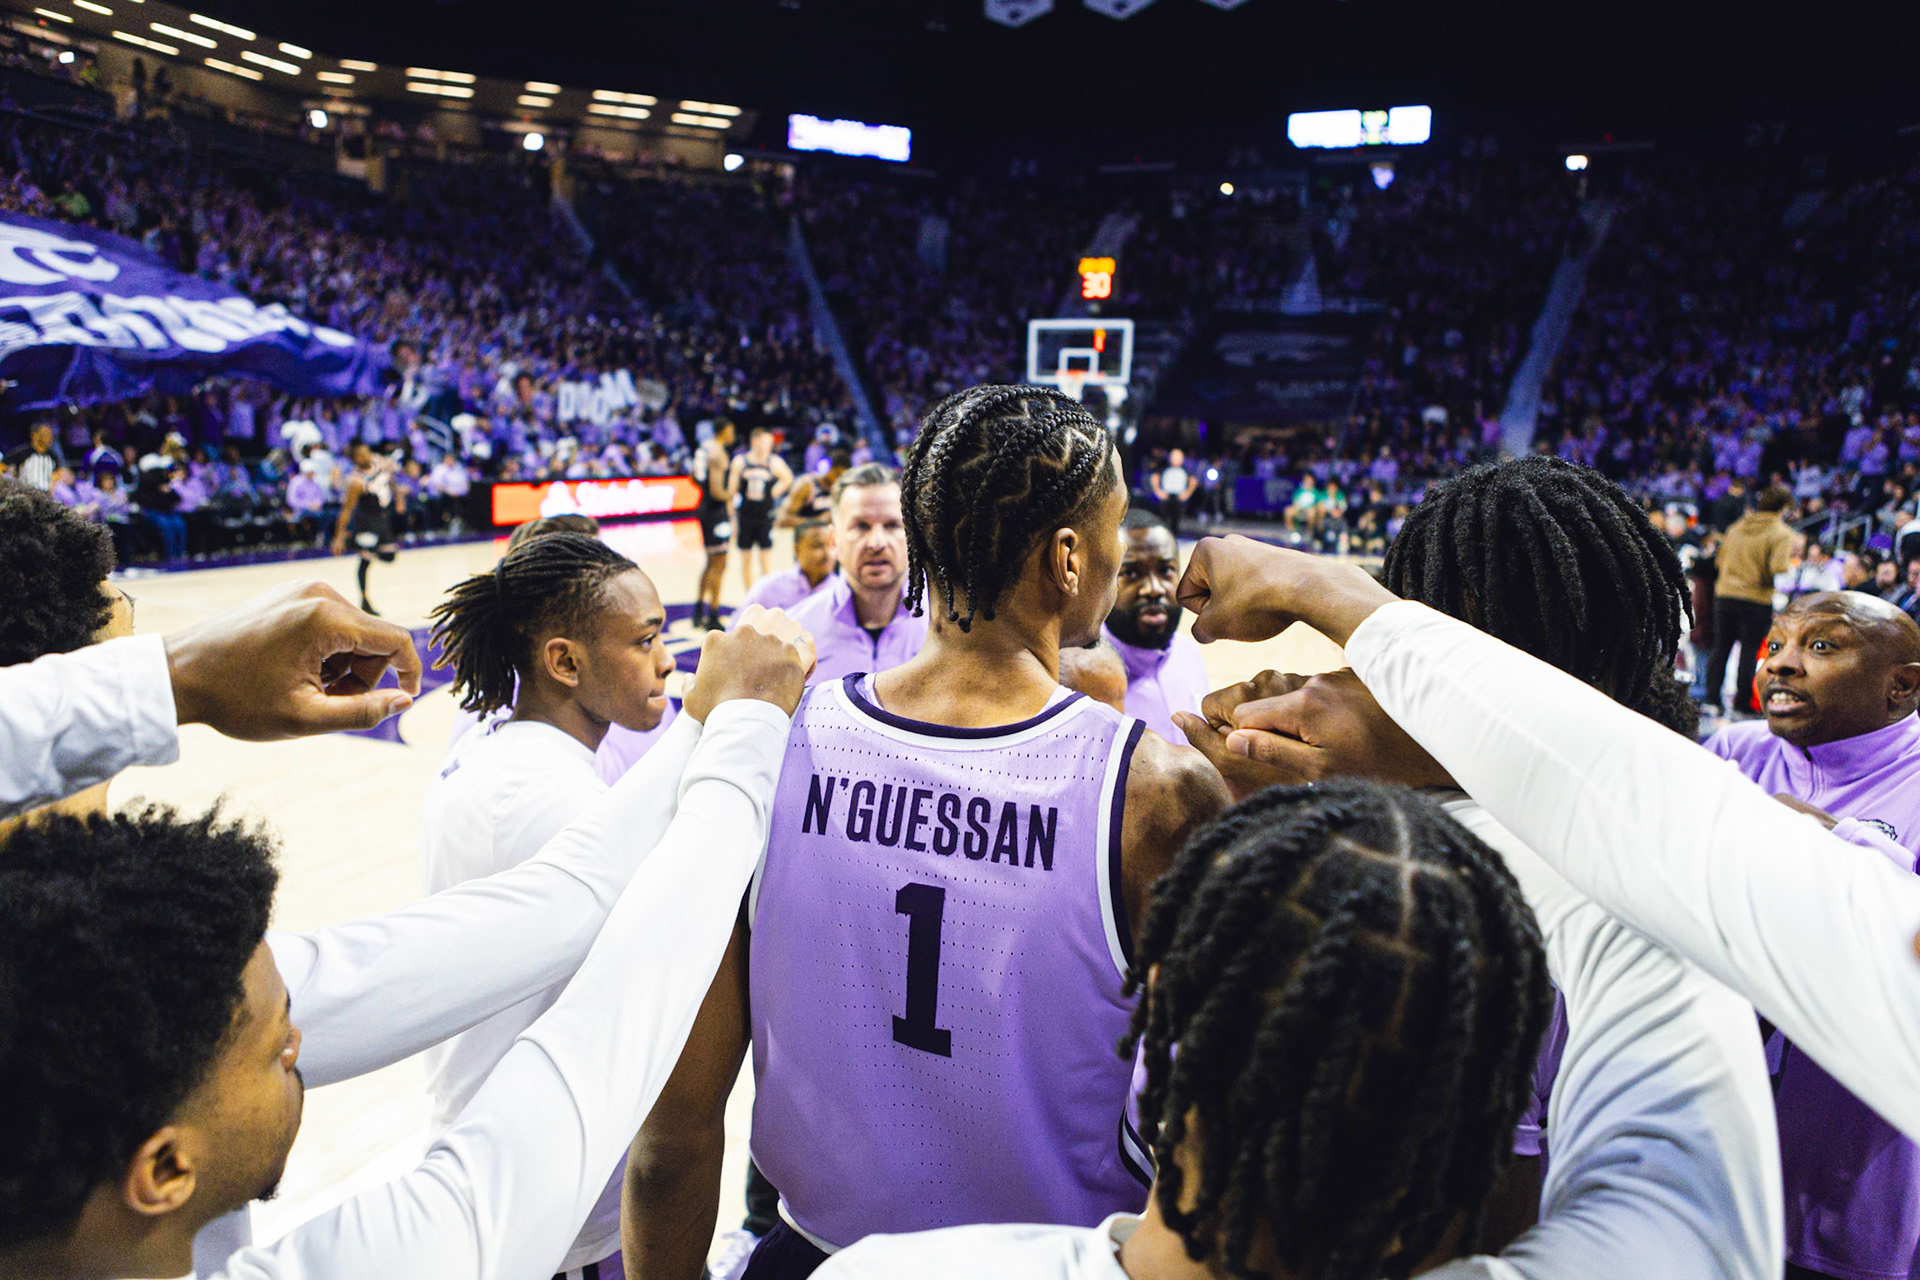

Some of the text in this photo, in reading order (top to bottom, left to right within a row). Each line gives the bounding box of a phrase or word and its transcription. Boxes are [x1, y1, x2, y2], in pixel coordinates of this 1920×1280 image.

[1081, 271, 1112, 299] 30
[802, 774, 1058, 871] N'GUESSAN
[892, 882, 952, 1058] 1
